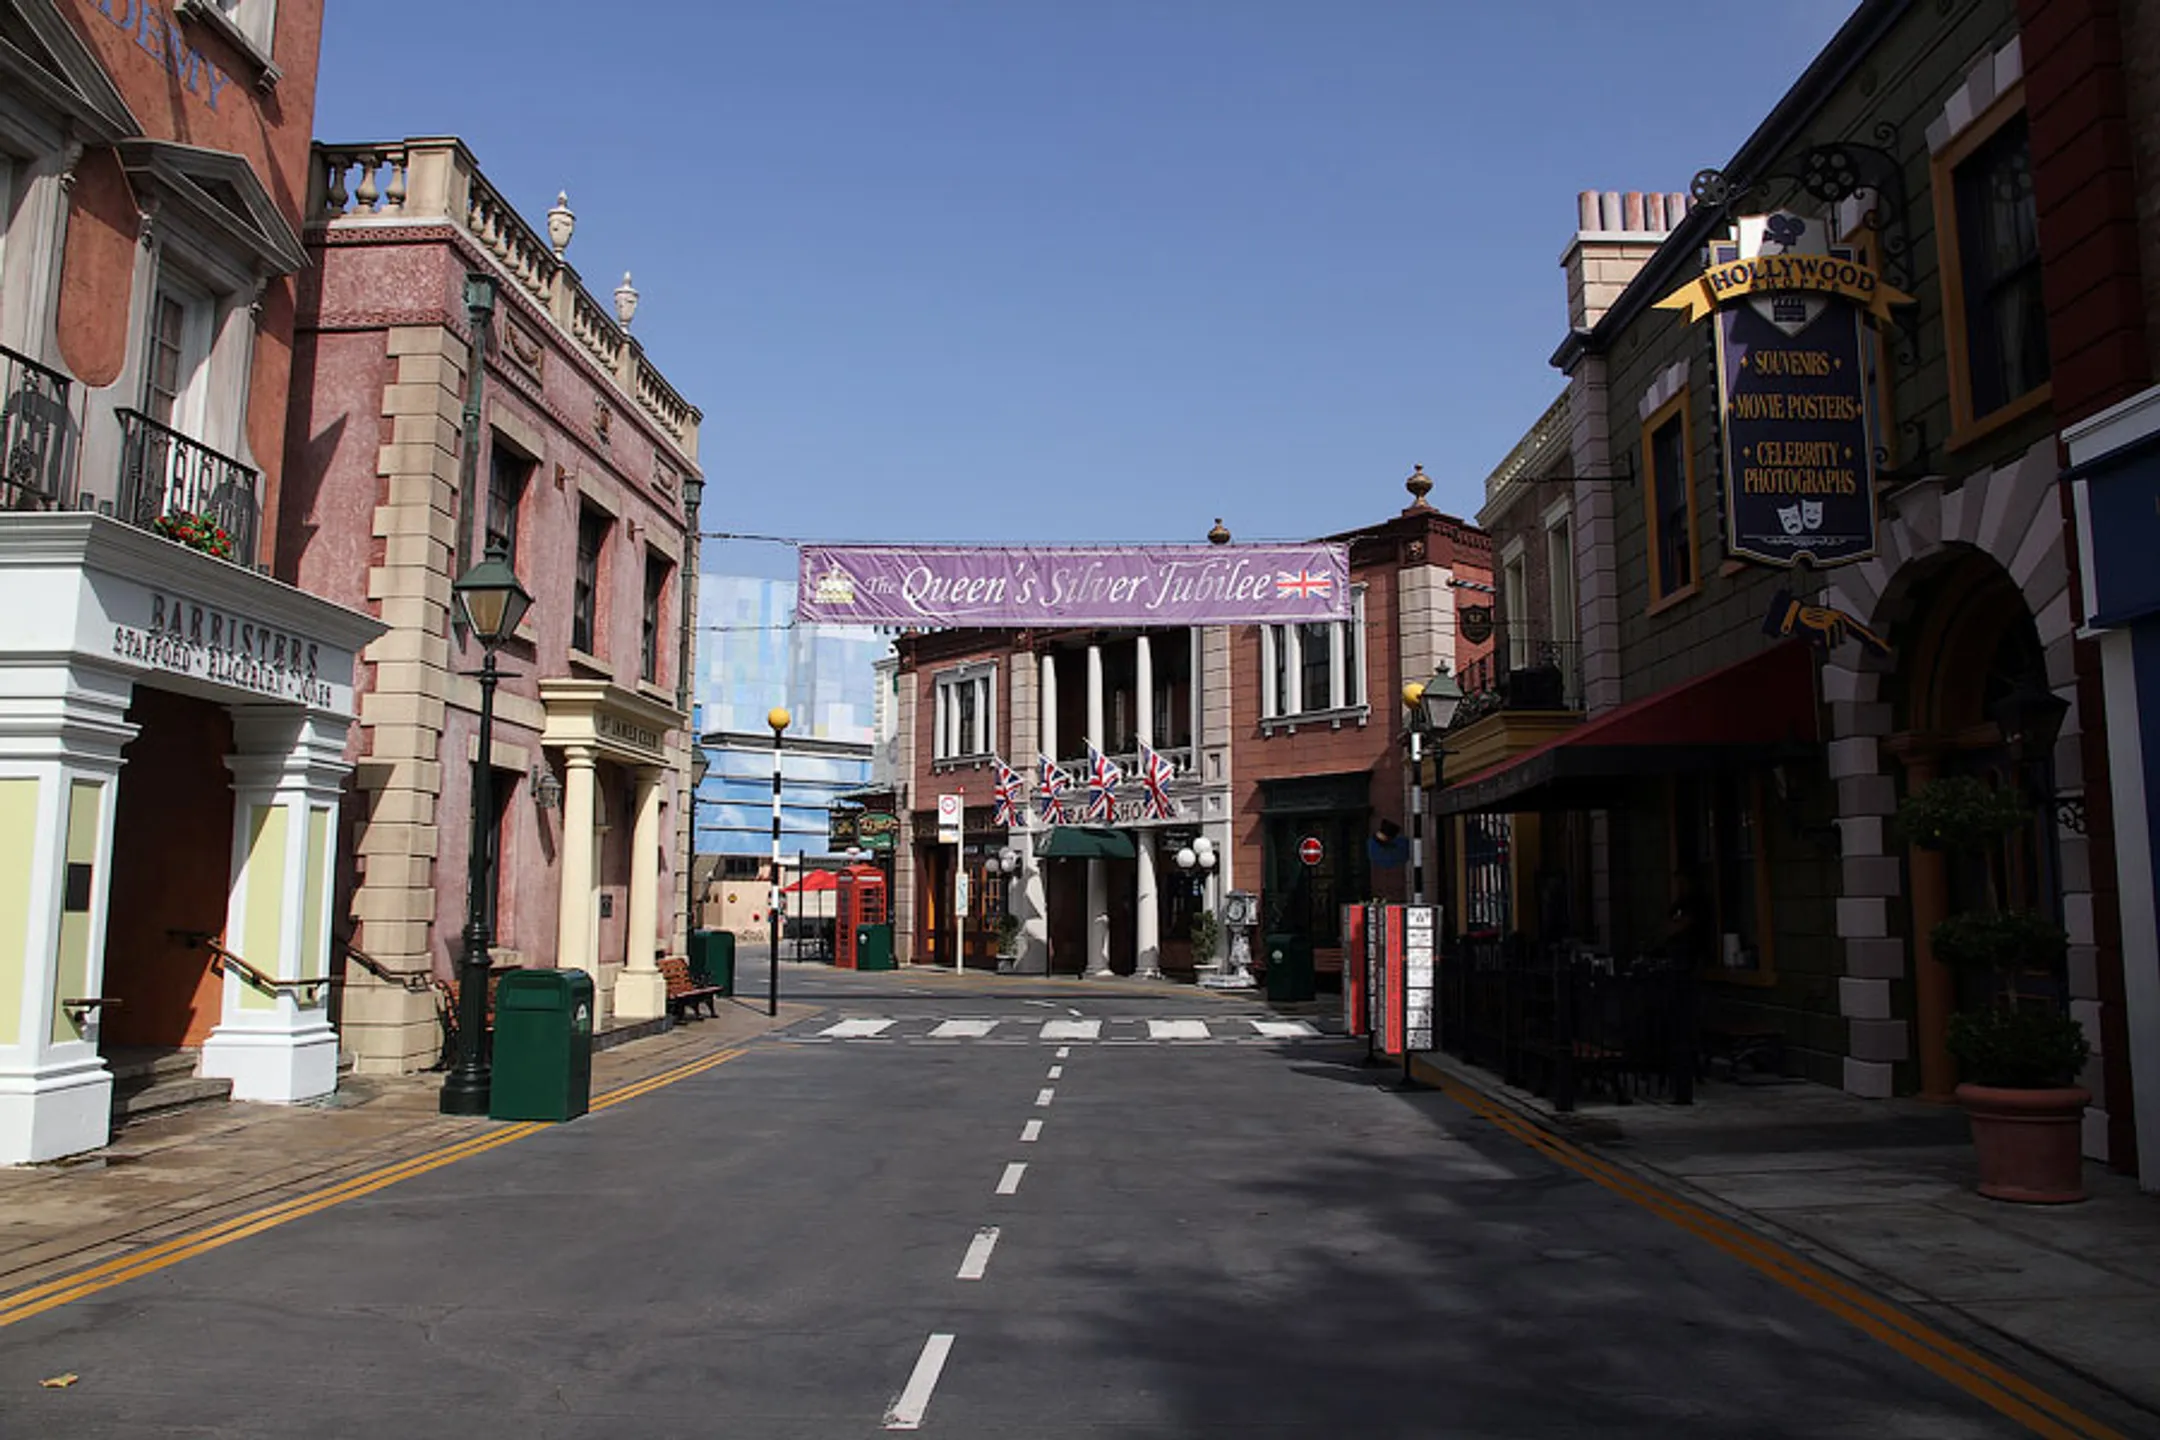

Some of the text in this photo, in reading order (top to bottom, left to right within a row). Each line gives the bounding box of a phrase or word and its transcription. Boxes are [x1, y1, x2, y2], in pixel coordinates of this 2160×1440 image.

[1711, 257, 1876, 293] HOLLYWOOD
[1754, 350, 1831, 376] SOUVENIRS
[1735, 393, 1855, 421] MOVIE POSTERS
[1756, 441, 1840, 468] CELEBRITY
[1744, 467, 1857, 495] PHOTOGRAPHS
[864, 557, 1273, 616] The Queen's Silver Jubilee
[151, 593, 319, 675] BARRISTERS
